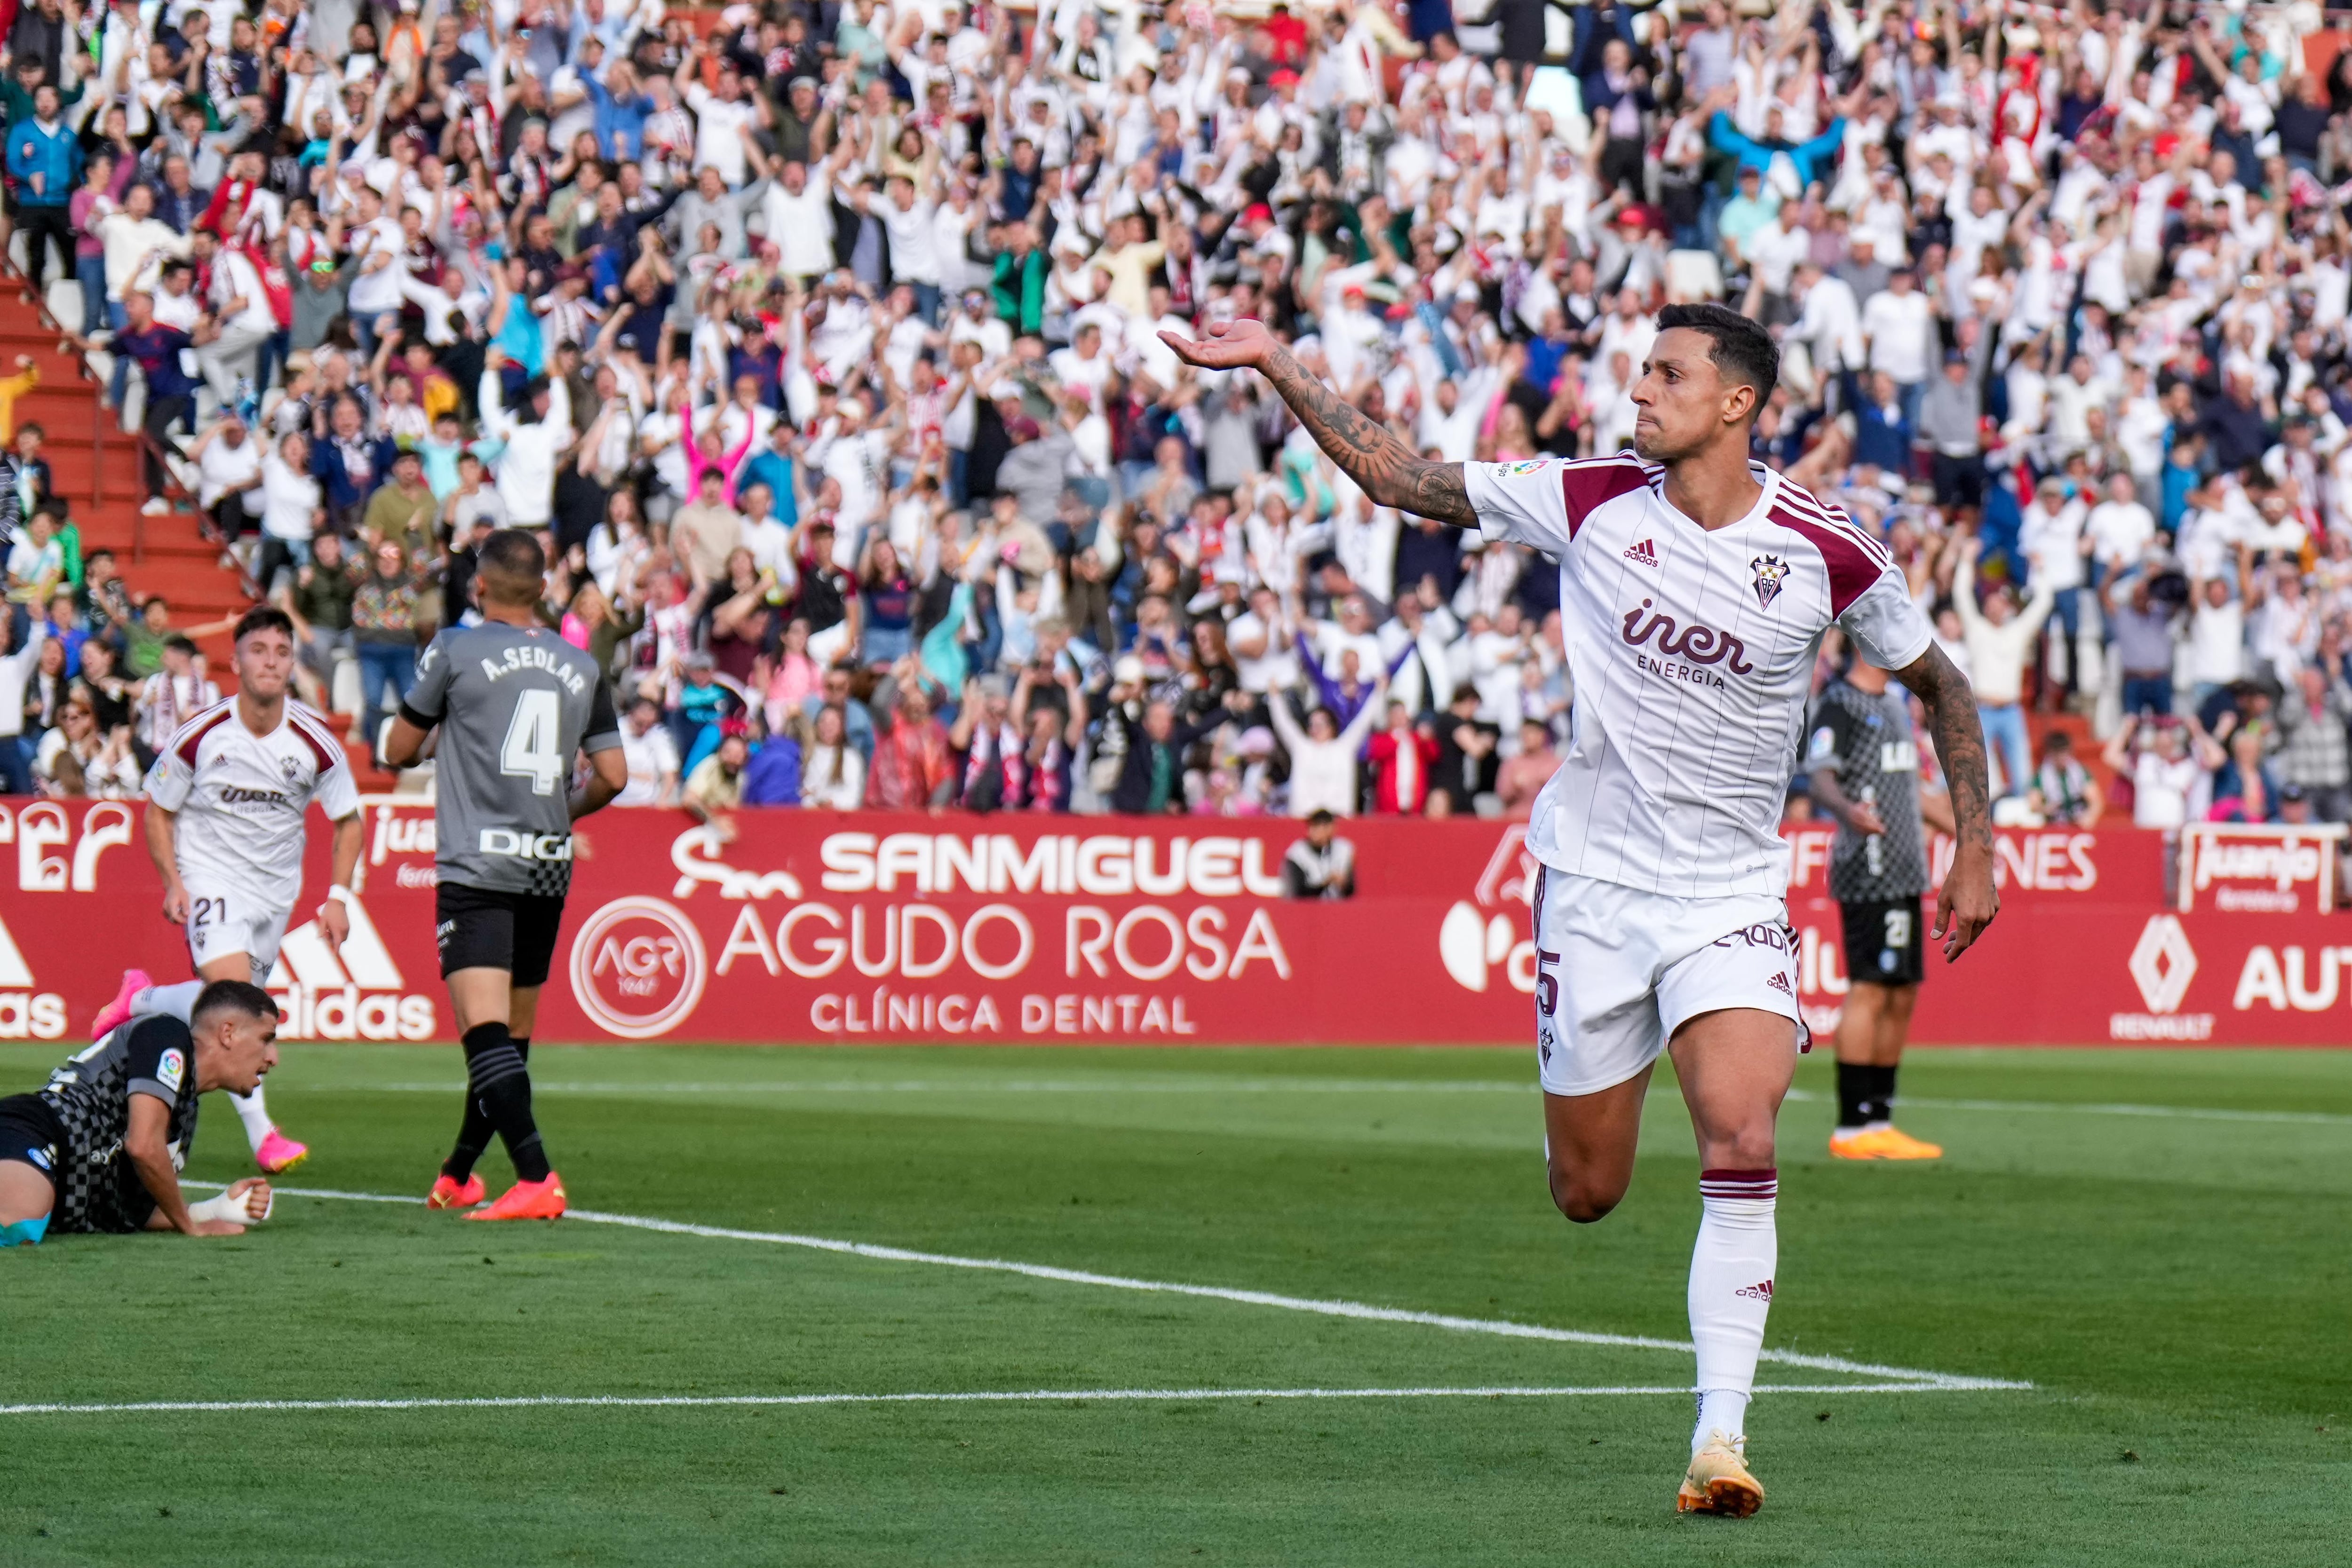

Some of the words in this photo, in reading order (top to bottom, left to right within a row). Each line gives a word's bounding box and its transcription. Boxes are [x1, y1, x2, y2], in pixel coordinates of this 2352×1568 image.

[1623, 550, 1658, 568] adidas
[1622, 598, 1753, 675] iner
[480, 646, 586, 697] A.SEDLAR
[1637, 654, 1725, 690] ENERGÍA
[500, 689, 564, 796] 4
[479, 829, 572, 861] DIGI
[820, 832, 1280, 896] SANMIGUEL
[2193, 834, 2320, 892] juanjo
[194, 897, 226, 927] 21
[1884, 909, 1912, 948] 21
[715, 902, 1035, 980] AGUDO
[1065, 904, 1293, 982] ROSA
[1537, 947, 1560, 1017] 5
[1767, 979, 1793, 998] adidas
[273, 981, 437, 1041] didas
[810, 984, 1002, 1034] CLÍNICA
[1021, 993, 1197, 1034] DENTAL
[2109, 1013, 2214, 1041] RENAULT
